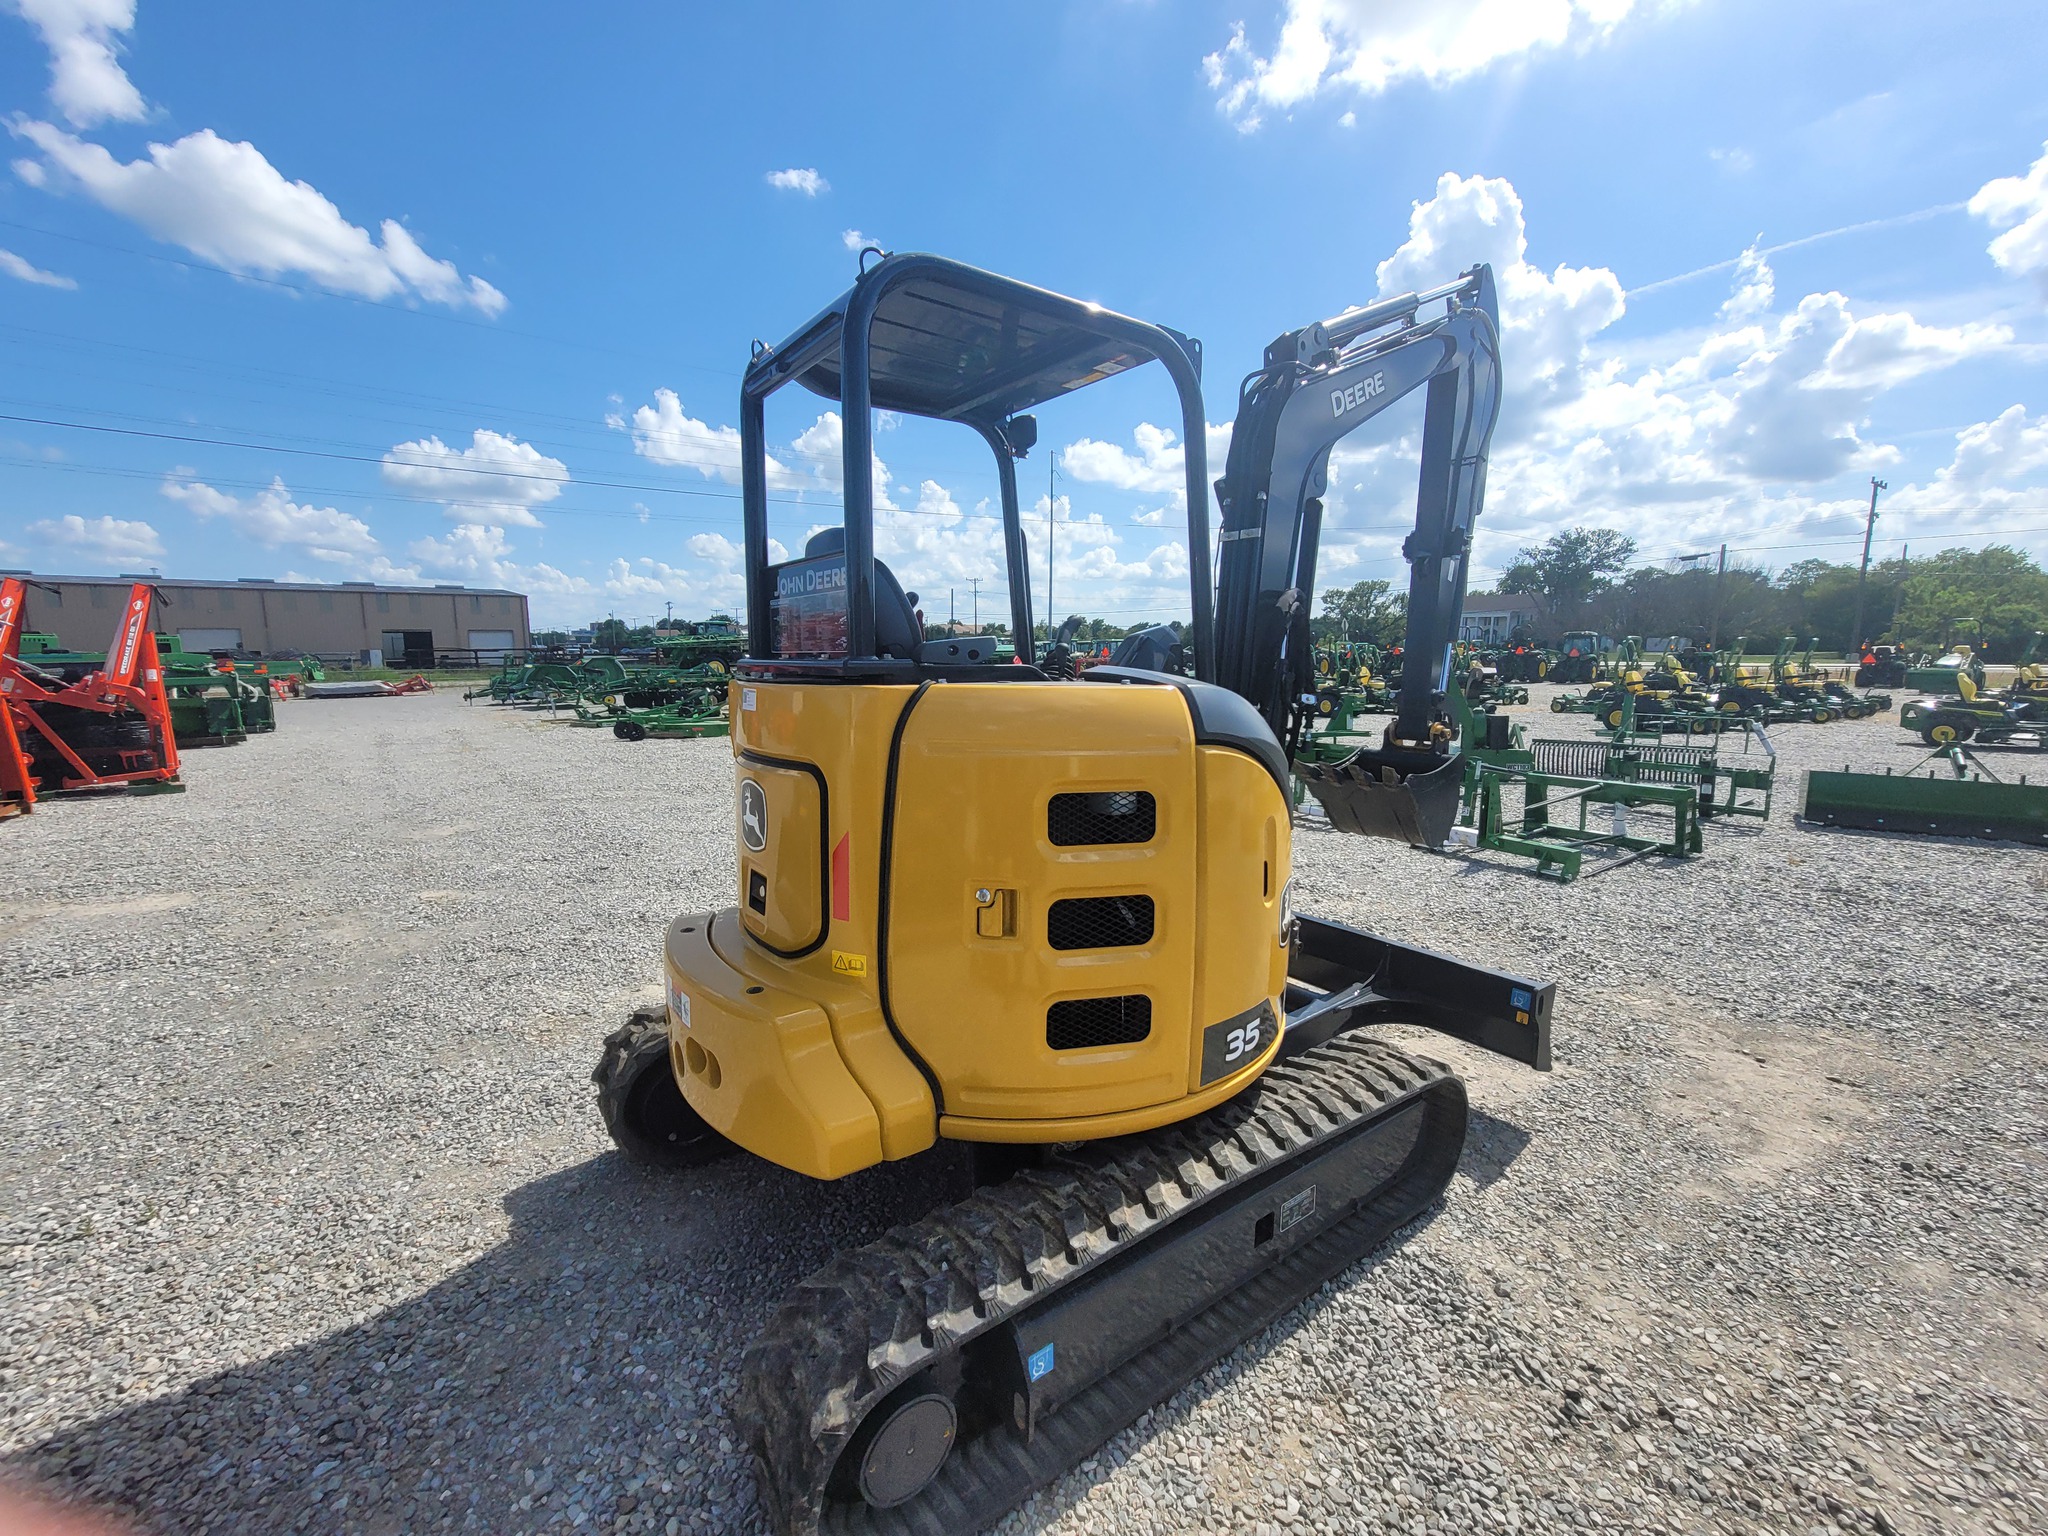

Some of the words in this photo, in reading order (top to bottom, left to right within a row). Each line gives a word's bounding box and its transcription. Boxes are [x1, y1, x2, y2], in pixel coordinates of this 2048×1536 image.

[1330, 371, 1385, 418] DEERE
[774, 575, 804, 597] JOHN
[1225, 1017, 1261, 1062] 35
